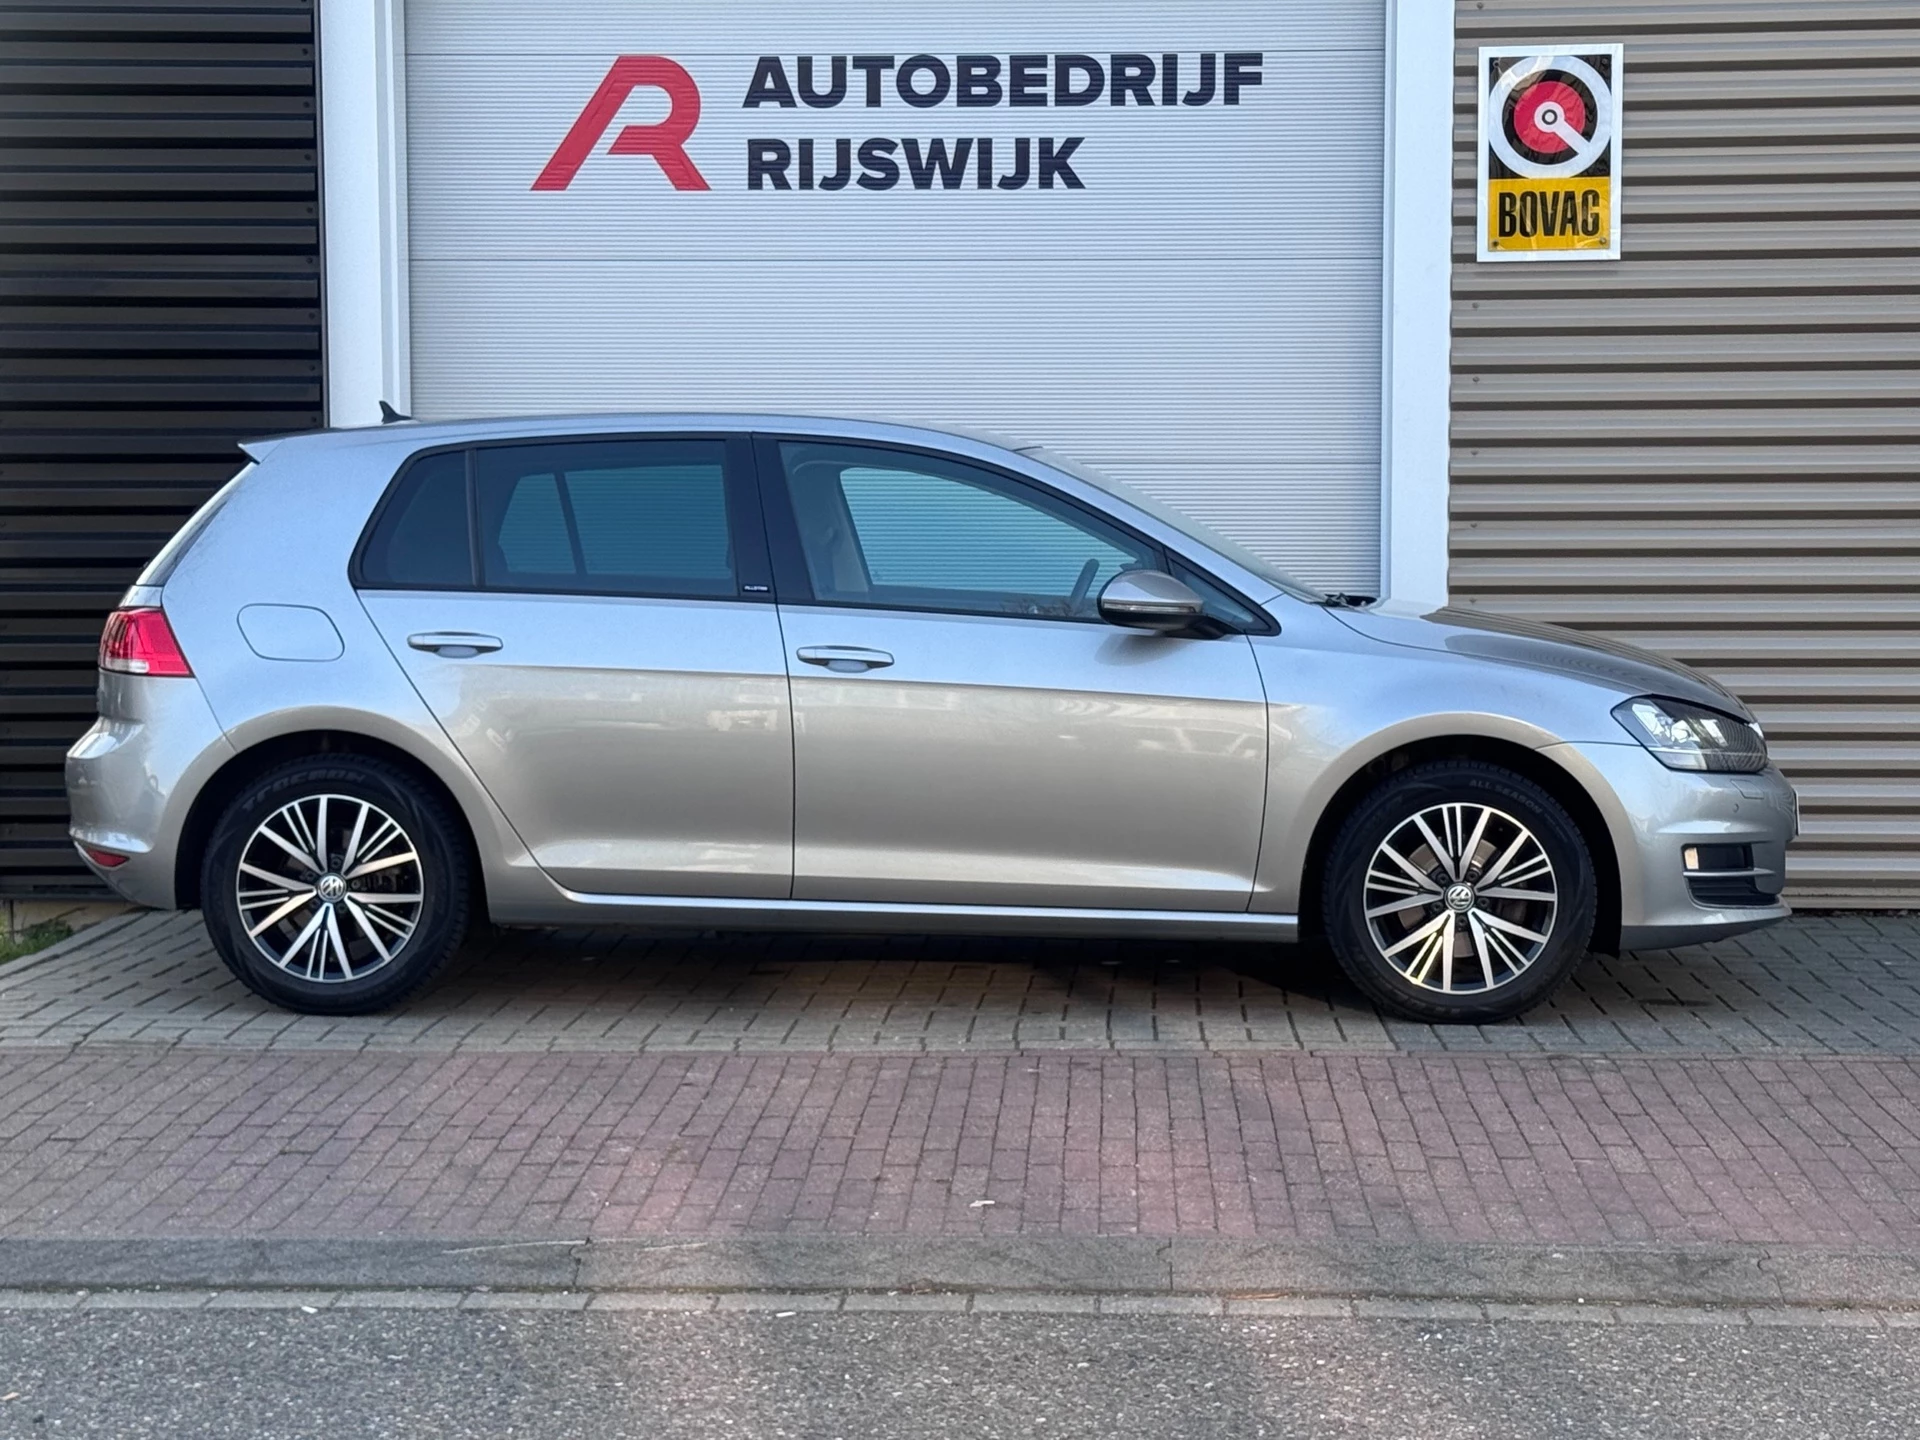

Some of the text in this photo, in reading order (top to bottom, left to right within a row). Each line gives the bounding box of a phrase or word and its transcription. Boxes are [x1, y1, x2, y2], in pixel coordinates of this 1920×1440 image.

[743, 53, 1263, 108] AUTOBEDRIJF
[747, 137, 1086, 190] RIJSWIJK
[1498, 189, 1600, 238] BOVAG
